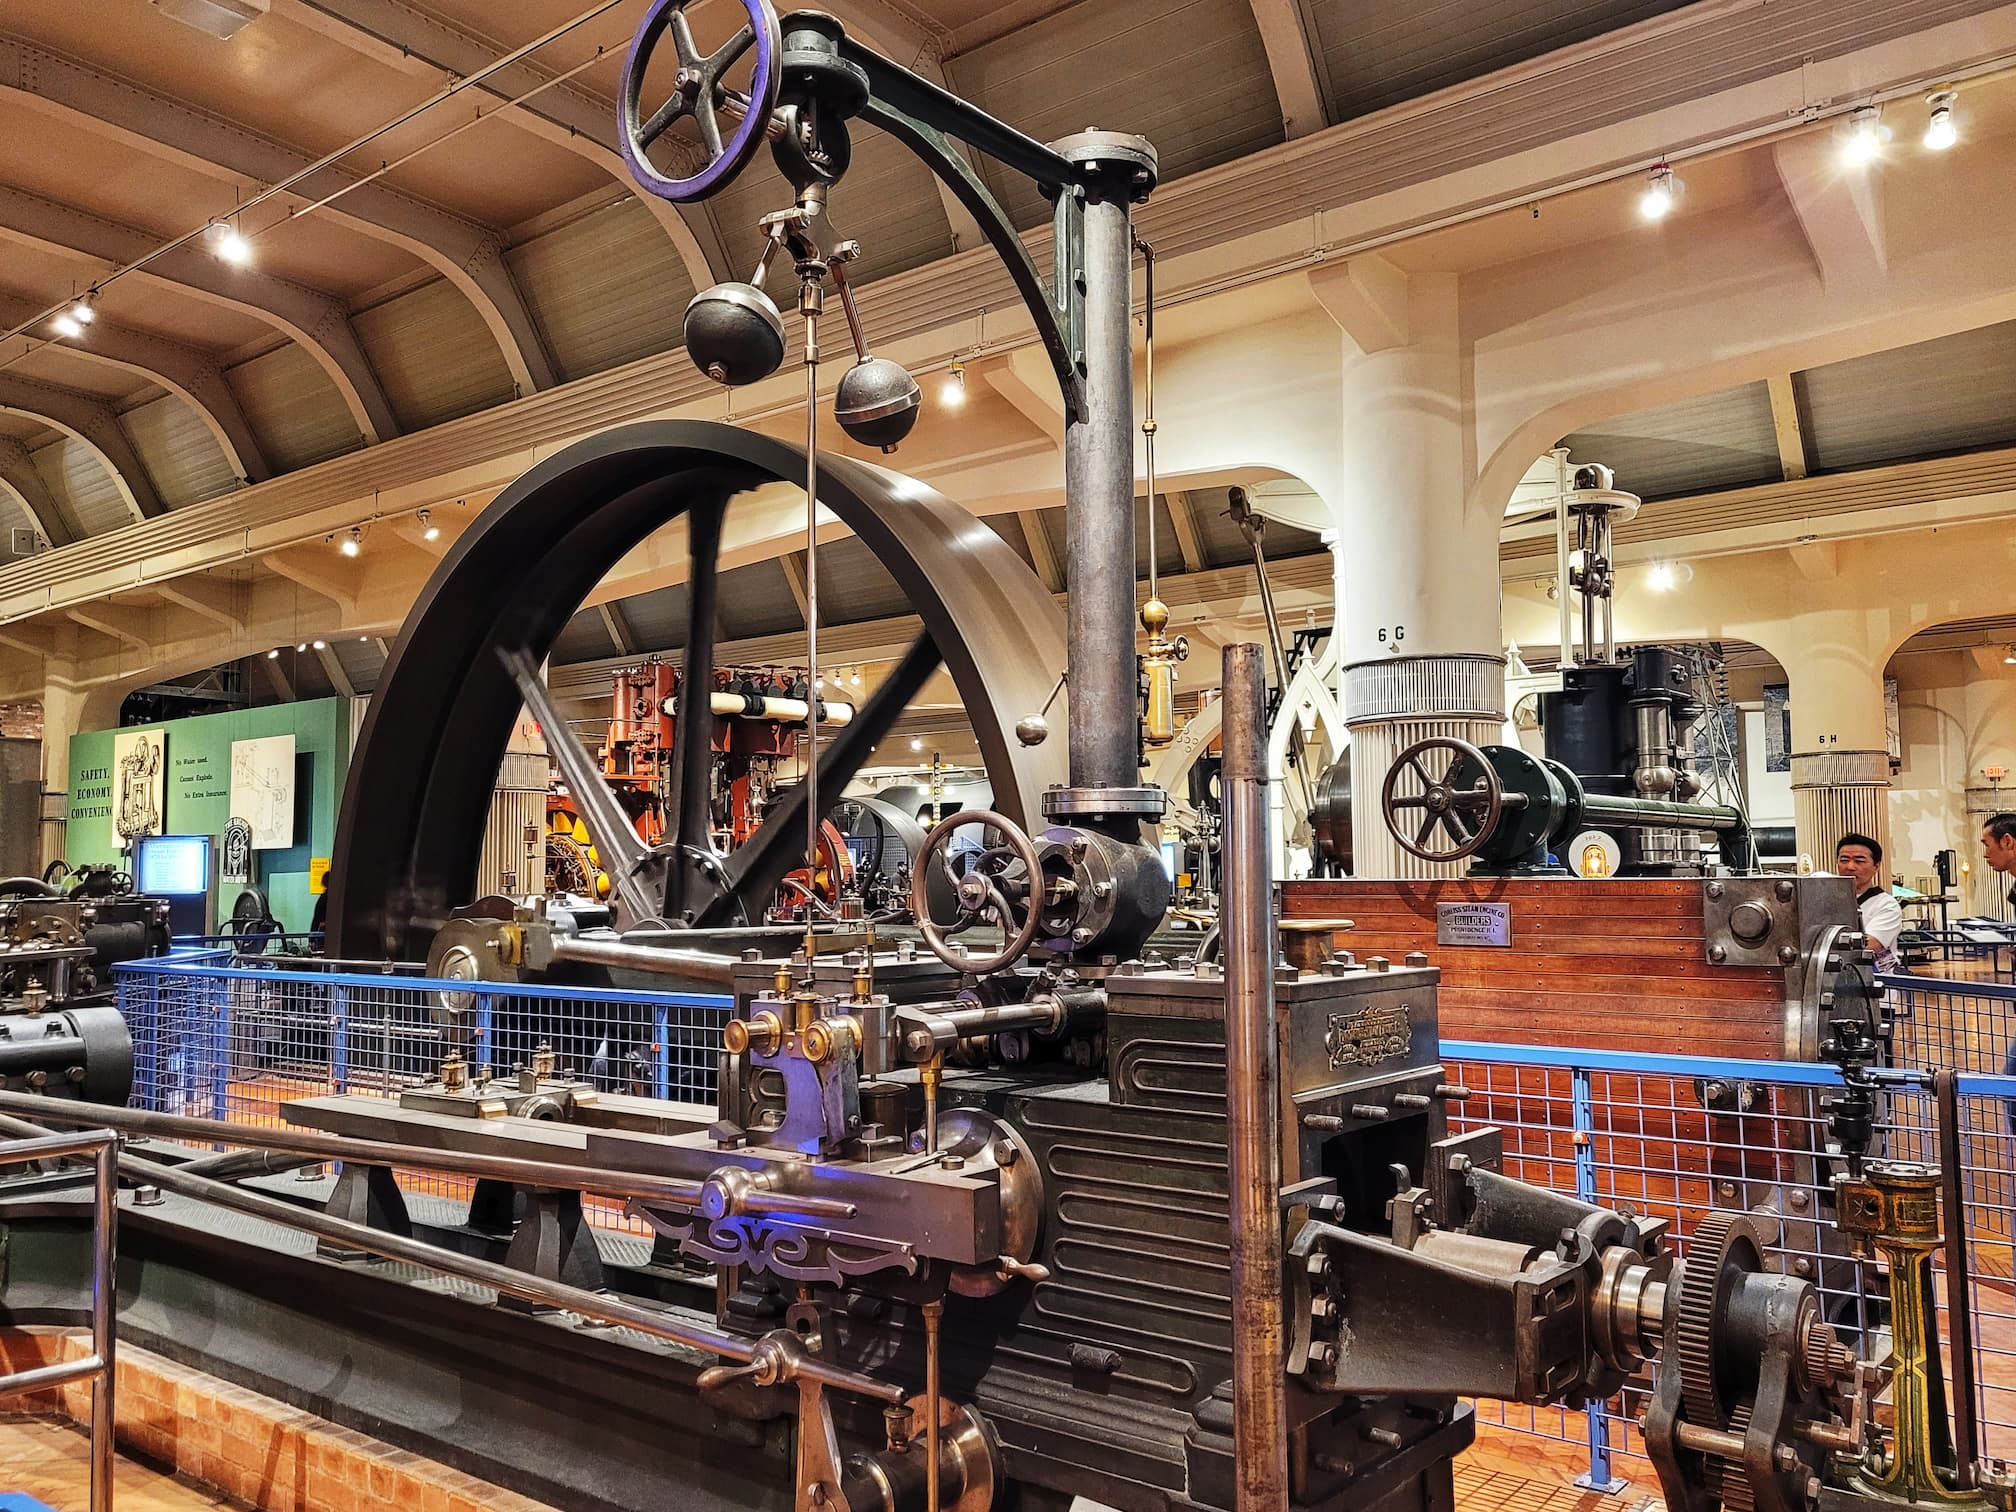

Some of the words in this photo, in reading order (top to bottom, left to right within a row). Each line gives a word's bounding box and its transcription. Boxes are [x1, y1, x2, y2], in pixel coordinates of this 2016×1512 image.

[1379, 628, 1386, 641] 6
[1395, 626, 1404, 640] G
[1819, 735, 1825, 743] 6
[1830, 734, 1837, 743] H
[1455, 916, 1491, 925] BUILDERS
